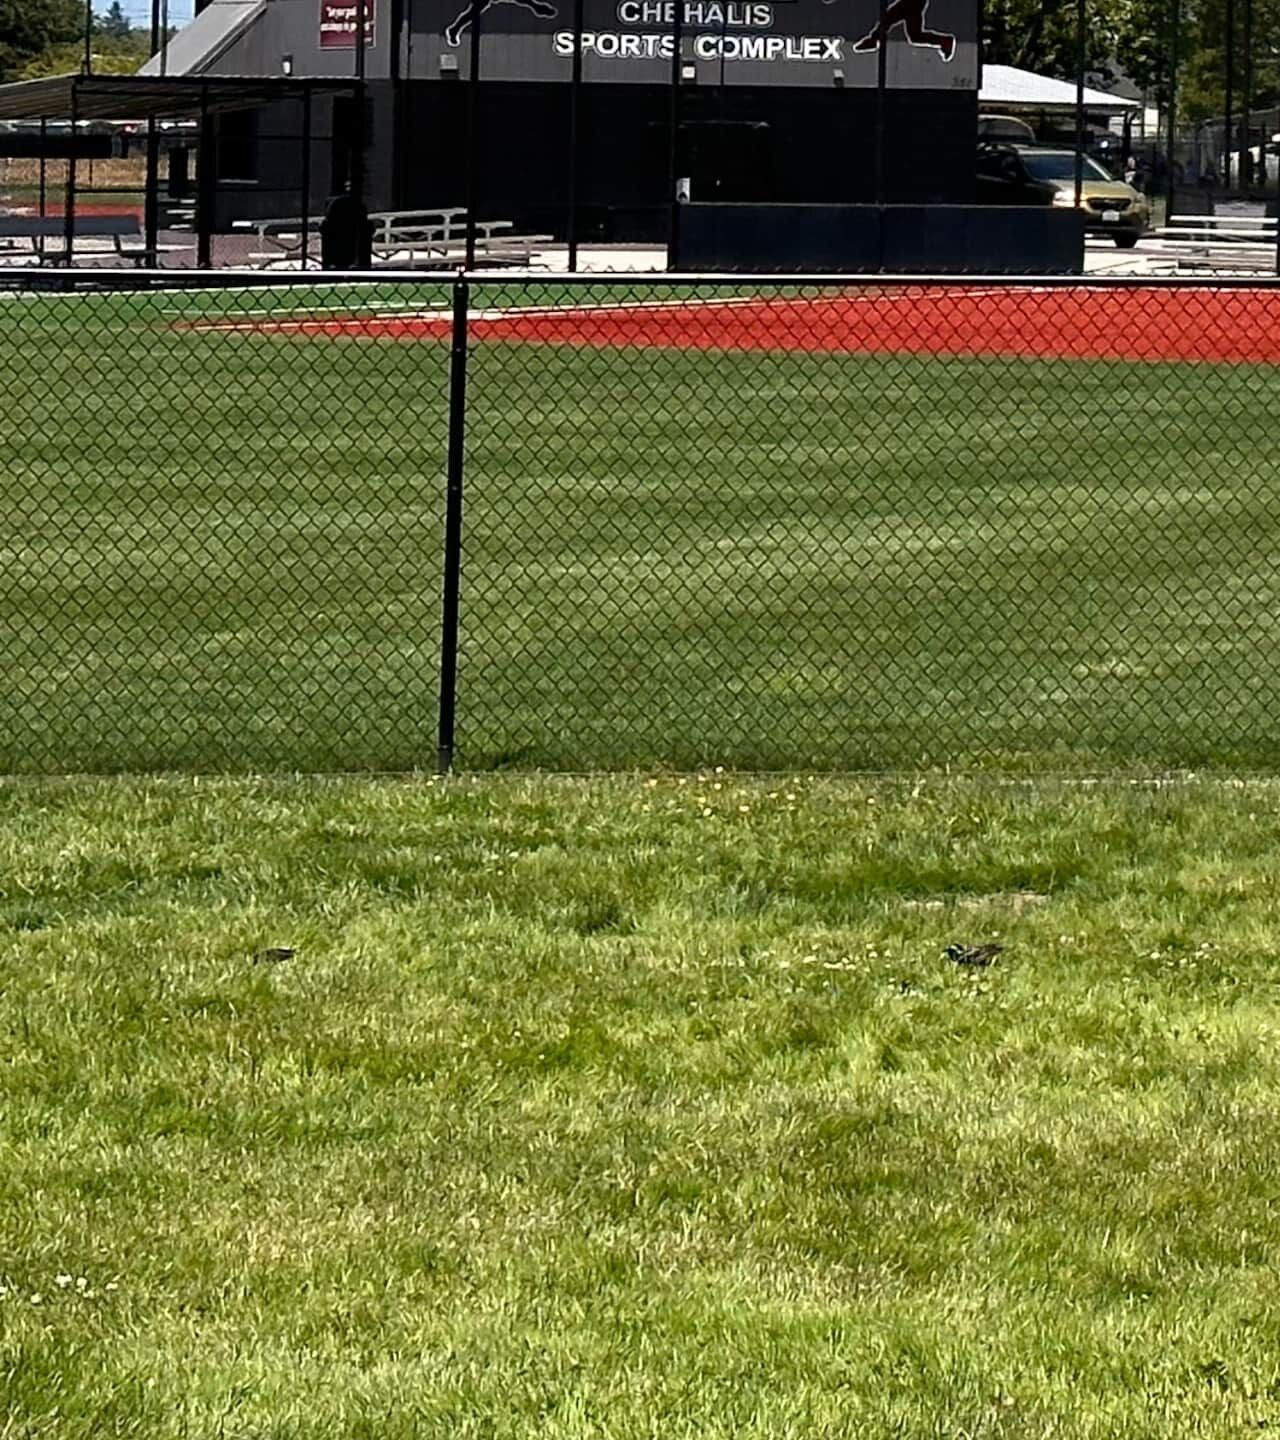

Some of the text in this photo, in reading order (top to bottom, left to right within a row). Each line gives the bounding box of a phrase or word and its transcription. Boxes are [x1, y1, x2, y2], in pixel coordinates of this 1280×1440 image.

[620, 1, 770, 25] CHEHALIS
[556, 32, 841, 60] SPORTS COMPLEX
